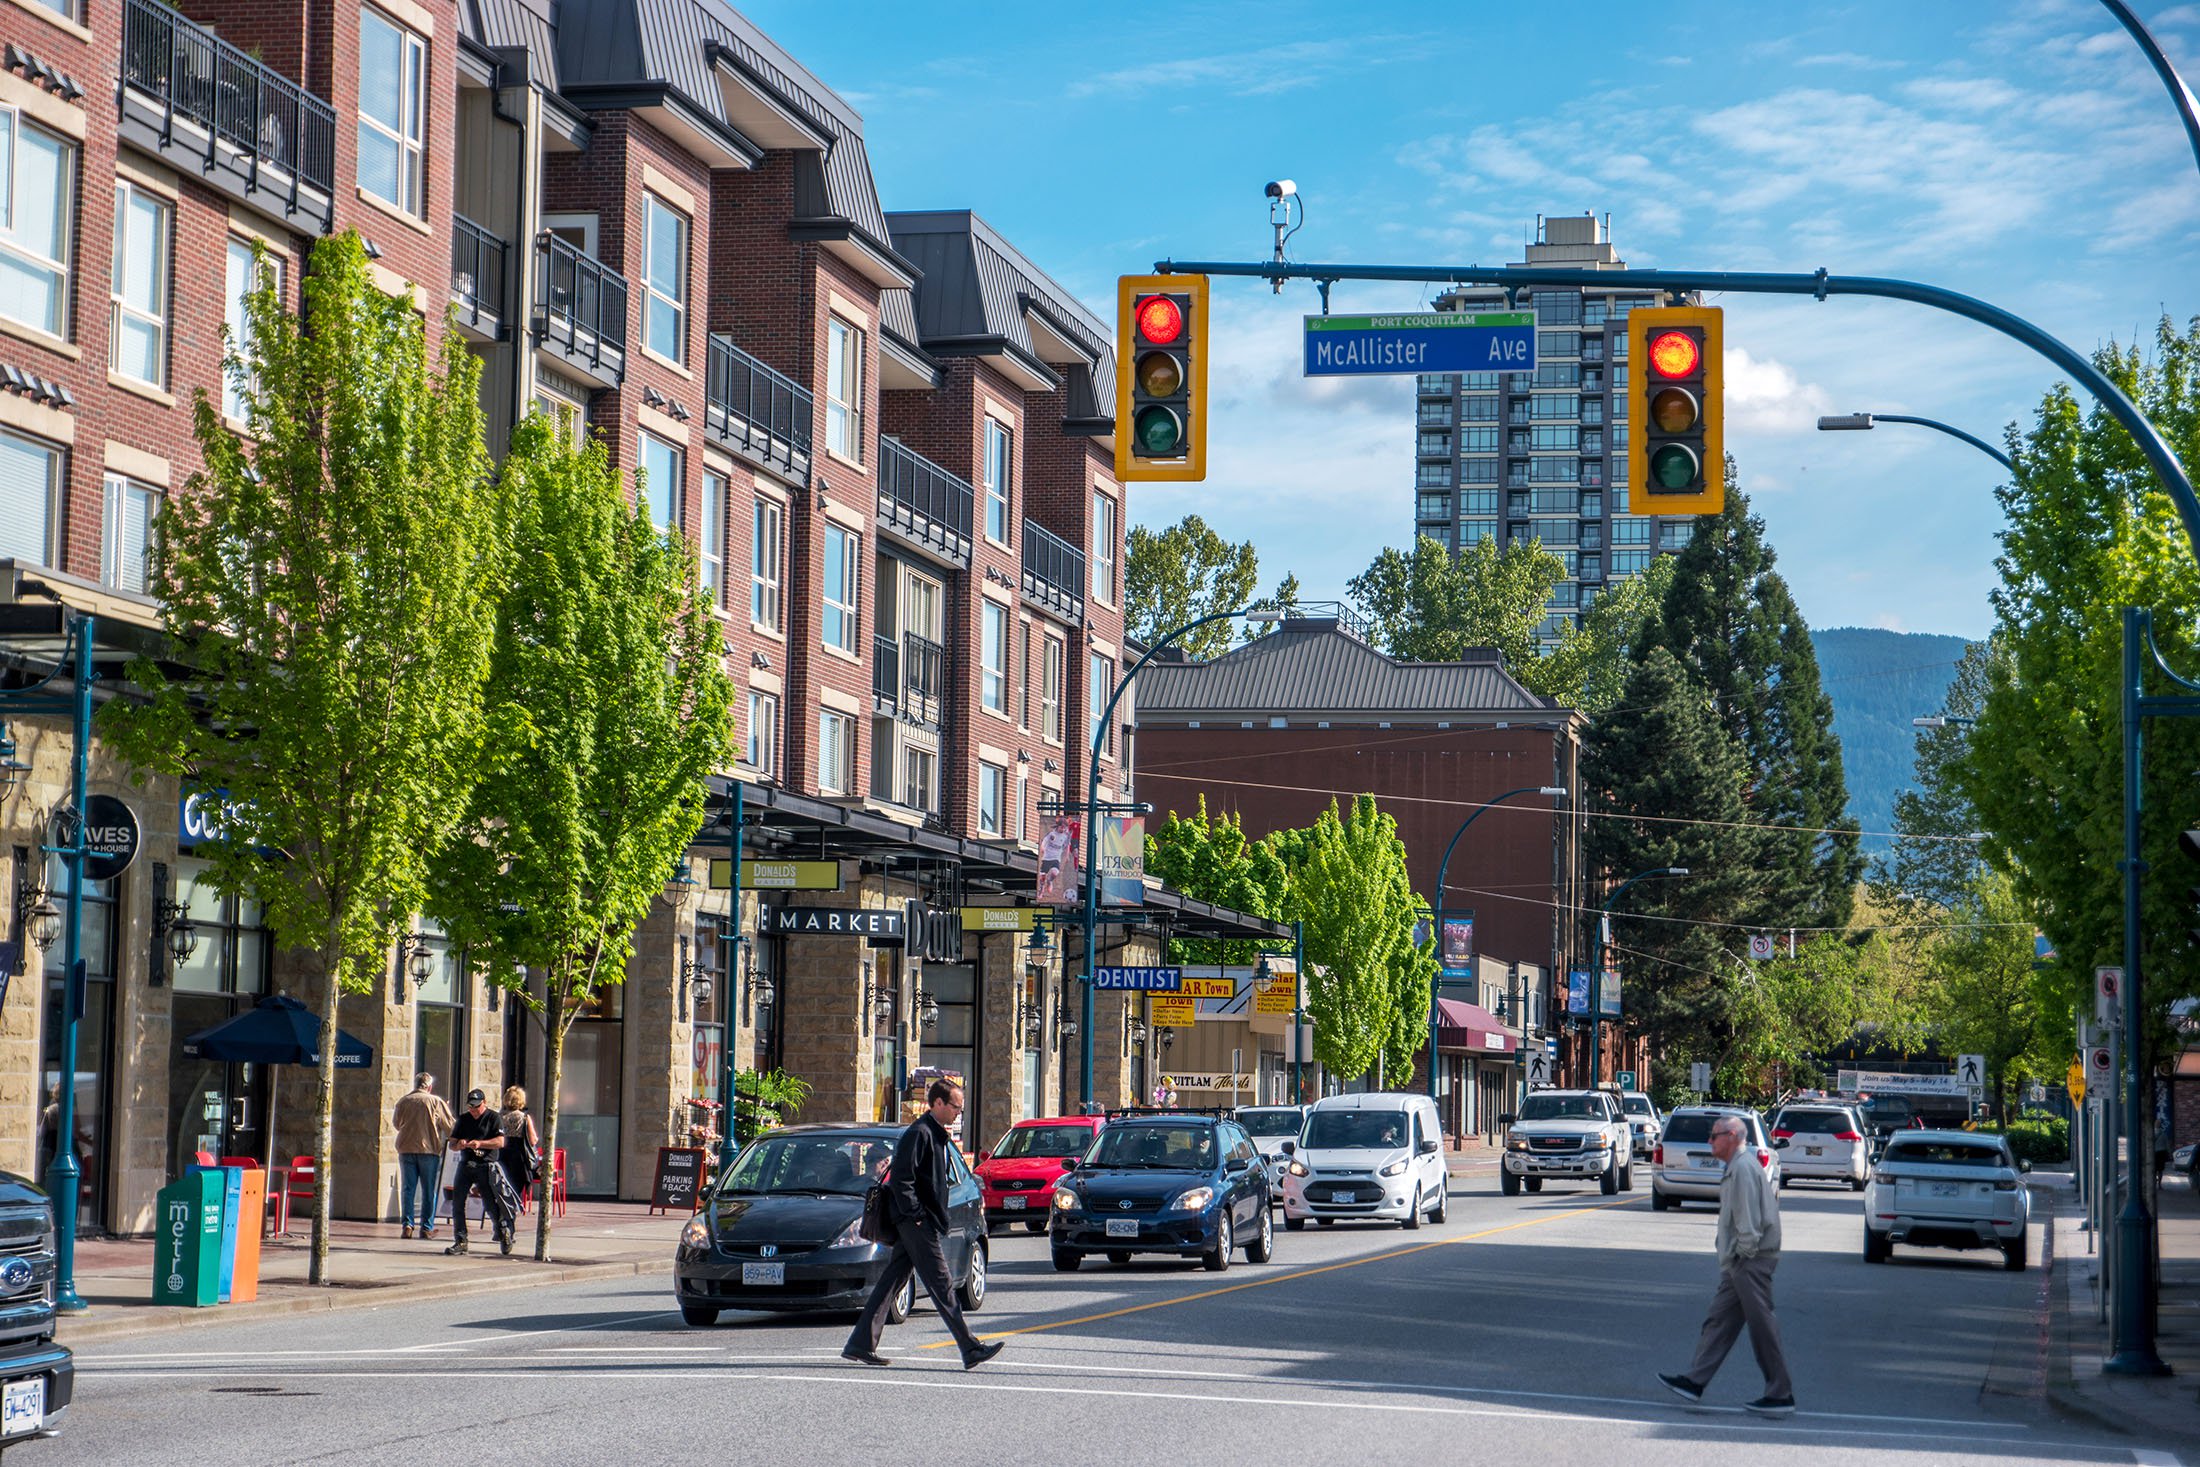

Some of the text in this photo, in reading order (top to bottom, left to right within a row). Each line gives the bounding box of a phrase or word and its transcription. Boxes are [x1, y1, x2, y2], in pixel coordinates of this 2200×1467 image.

[1371, 314, 1476, 328] PORT COQUITLAM
[1317, 336, 1527, 366] McAllister Ave
[100, 844, 130, 853] HOUSE
[779, 911, 897, 933] MARKET
[1098, 968, 1178, 988] DENTIST
[1205, 981, 1229, 995] Town
[334, 1055, 361, 1063] COFFEE
[1620, 1074, 1631, 1087] P
[1862, 1074, 1879, 1082] Join
[1891, 1076, 1908, 1084] May
[1922, 1077, 1937, 1085] May
[662, 1175, 693, 1185] PARKING
[667, 1183, 692, 1193] BACK
